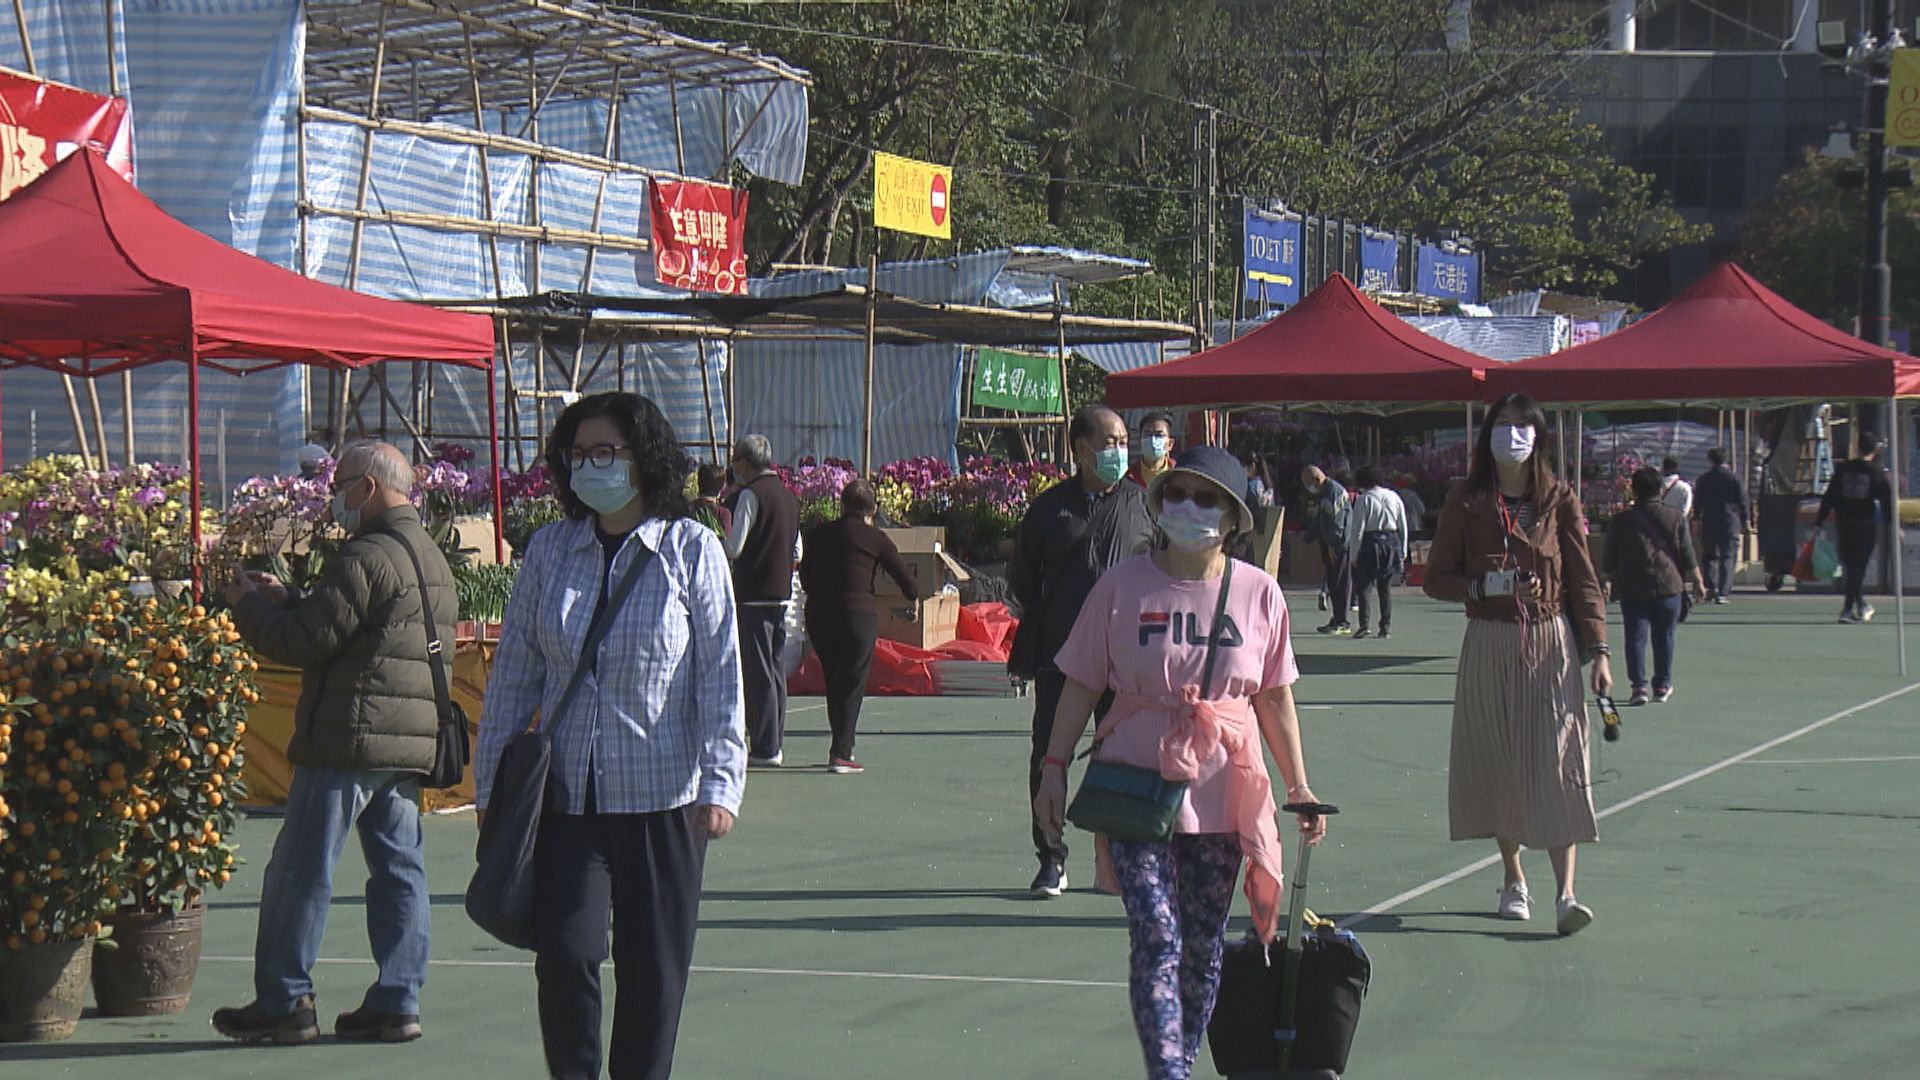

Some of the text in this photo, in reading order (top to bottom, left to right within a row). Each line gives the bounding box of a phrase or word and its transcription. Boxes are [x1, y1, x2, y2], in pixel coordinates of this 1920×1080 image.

[893, 193, 926, 215] NO EXIT
[1138, 611, 1244, 647] FILA
